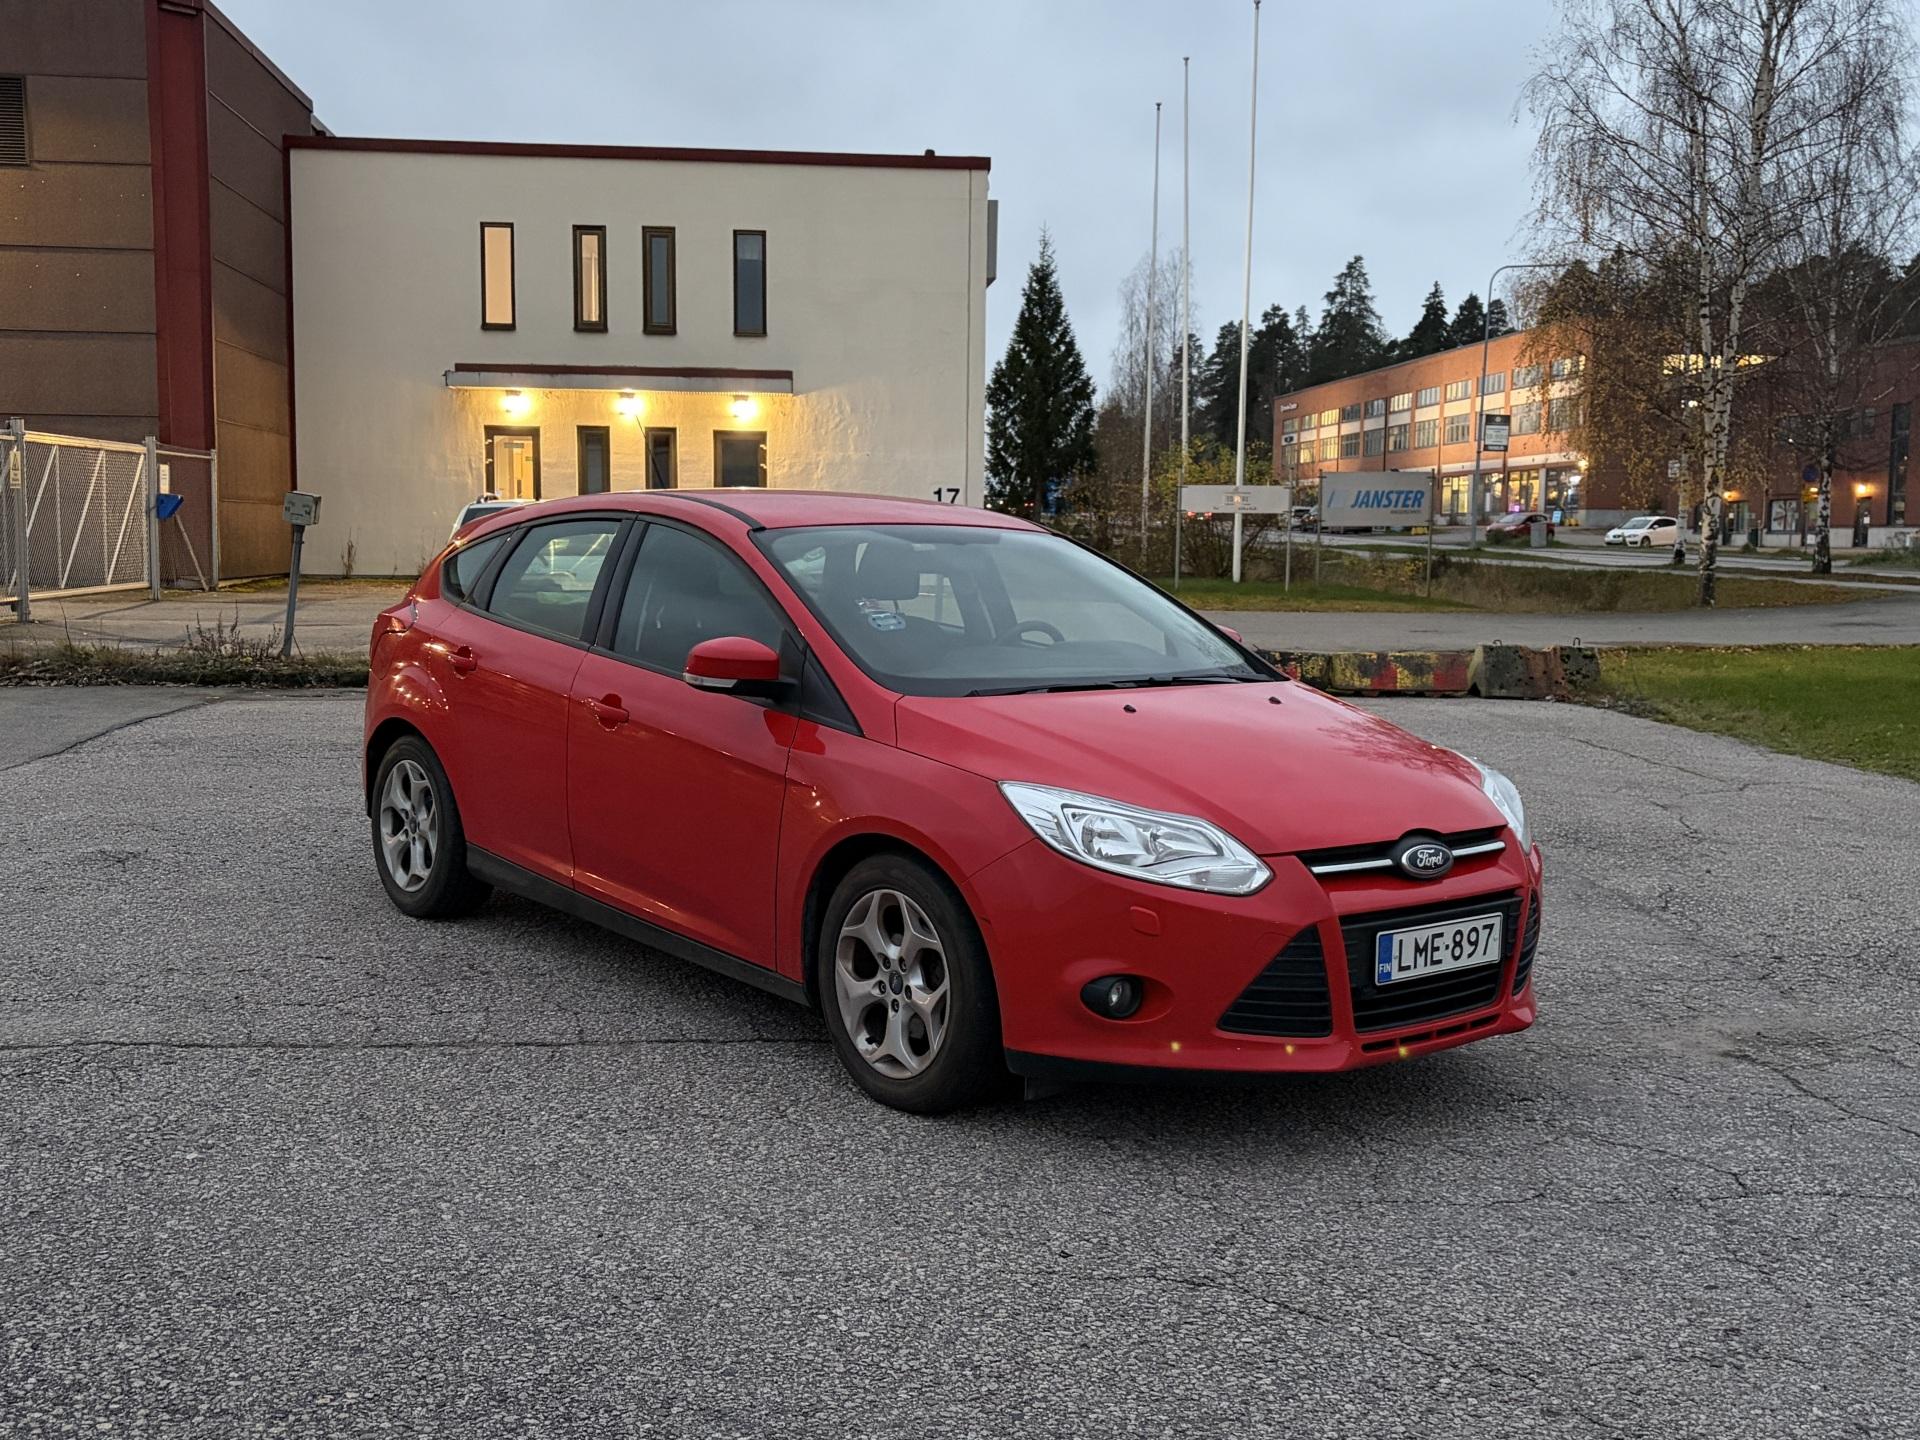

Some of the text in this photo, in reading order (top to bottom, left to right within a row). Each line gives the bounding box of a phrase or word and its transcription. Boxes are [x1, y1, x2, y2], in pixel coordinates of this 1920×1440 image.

[933, 487, 960, 504] 17
[1351, 489, 1425, 509] JANSTER
[1417, 849, 1444, 868] Ford
[1397, 923, 1495, 972] LME-897
[1379, 962, 1391, 974] FIN
